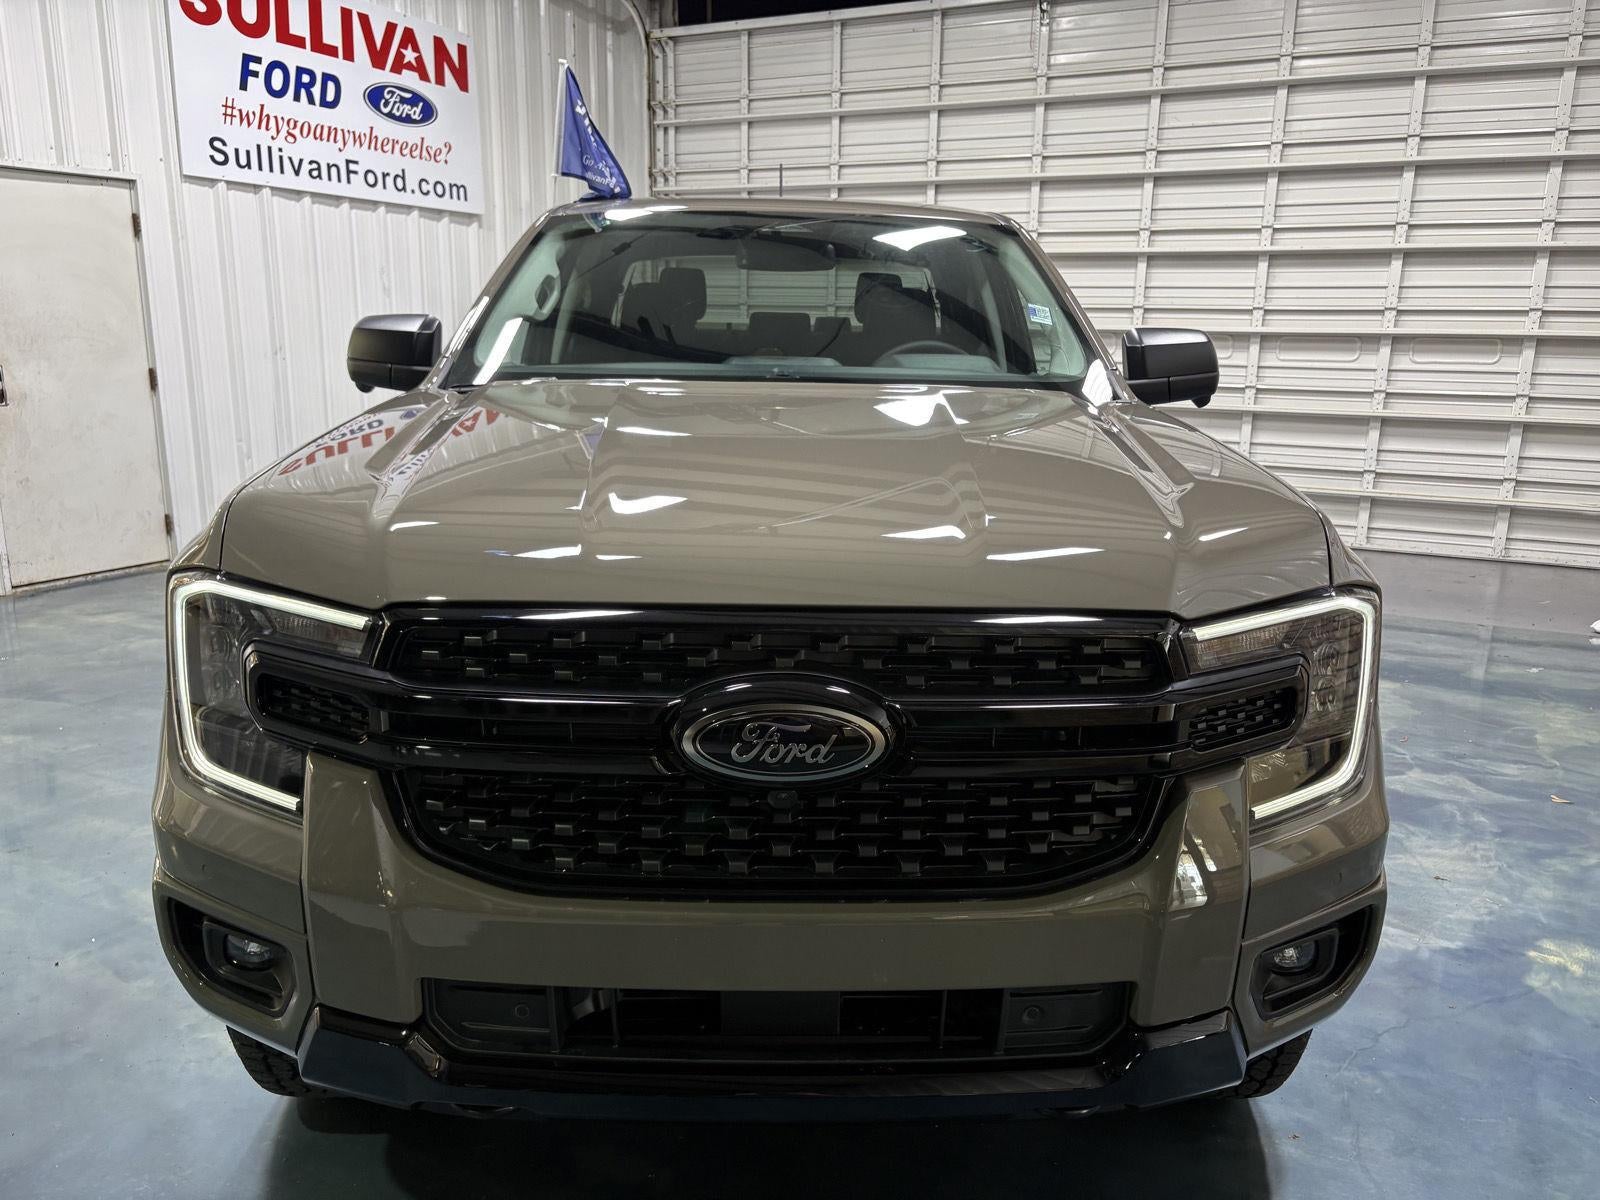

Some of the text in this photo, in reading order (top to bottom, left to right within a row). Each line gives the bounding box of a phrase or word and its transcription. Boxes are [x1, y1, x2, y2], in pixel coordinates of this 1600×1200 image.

[239, 53, 341, 109] FORD
[380, 88, 424, 121] Ford
[221, 96, 452, 164] #whygoanywhereelse?
[208, 136, 468, 202] SullivanFord.com
[730, 721, 838, 764] Ford
